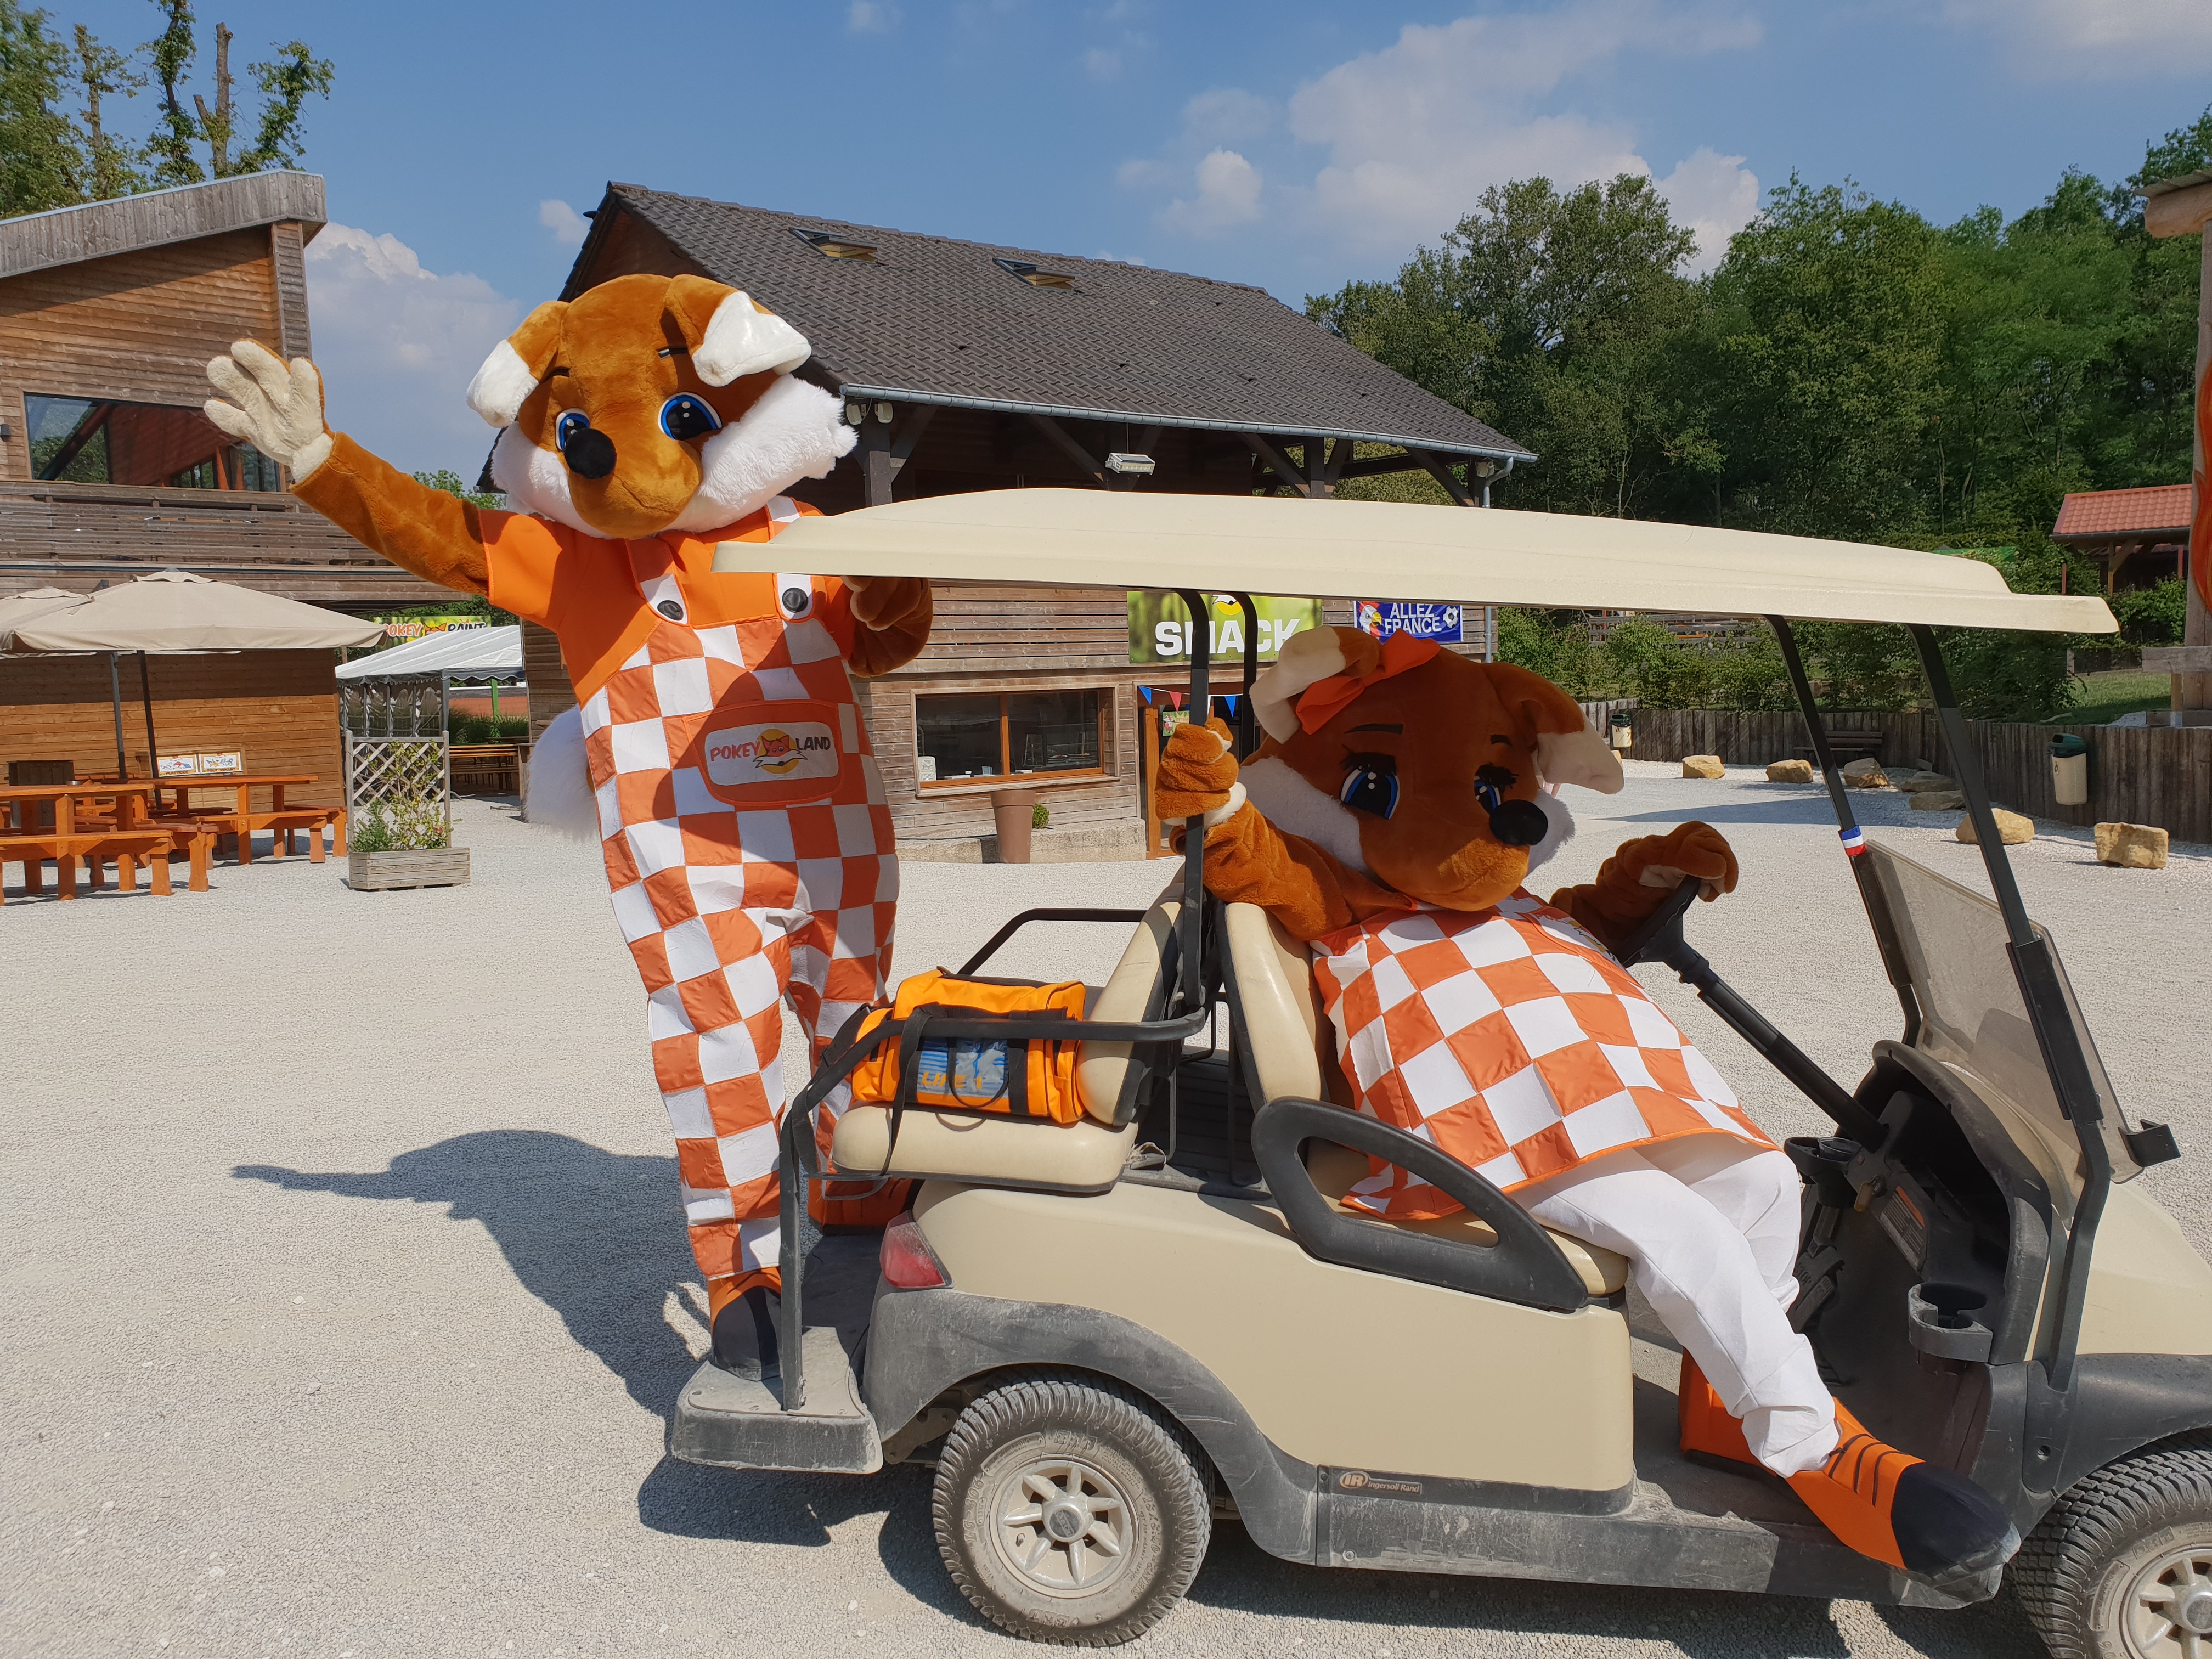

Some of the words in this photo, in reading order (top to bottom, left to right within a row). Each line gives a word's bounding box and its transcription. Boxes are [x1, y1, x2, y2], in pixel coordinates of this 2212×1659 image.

[1390, 602, 1435, 619] ALLEZ
[1384, 616, 1442, 634] FRANCE
[710, 740, 761, 762] POKEY
[795, 736, 831, 751] LAND
[973, 1075, 983, 1090] 1
[1344, 1474, 1364, 1487] IR
[1368, 1482, 1400, 1491] Ingersoll
[1400, 1485, 1420, 1493] Rand
